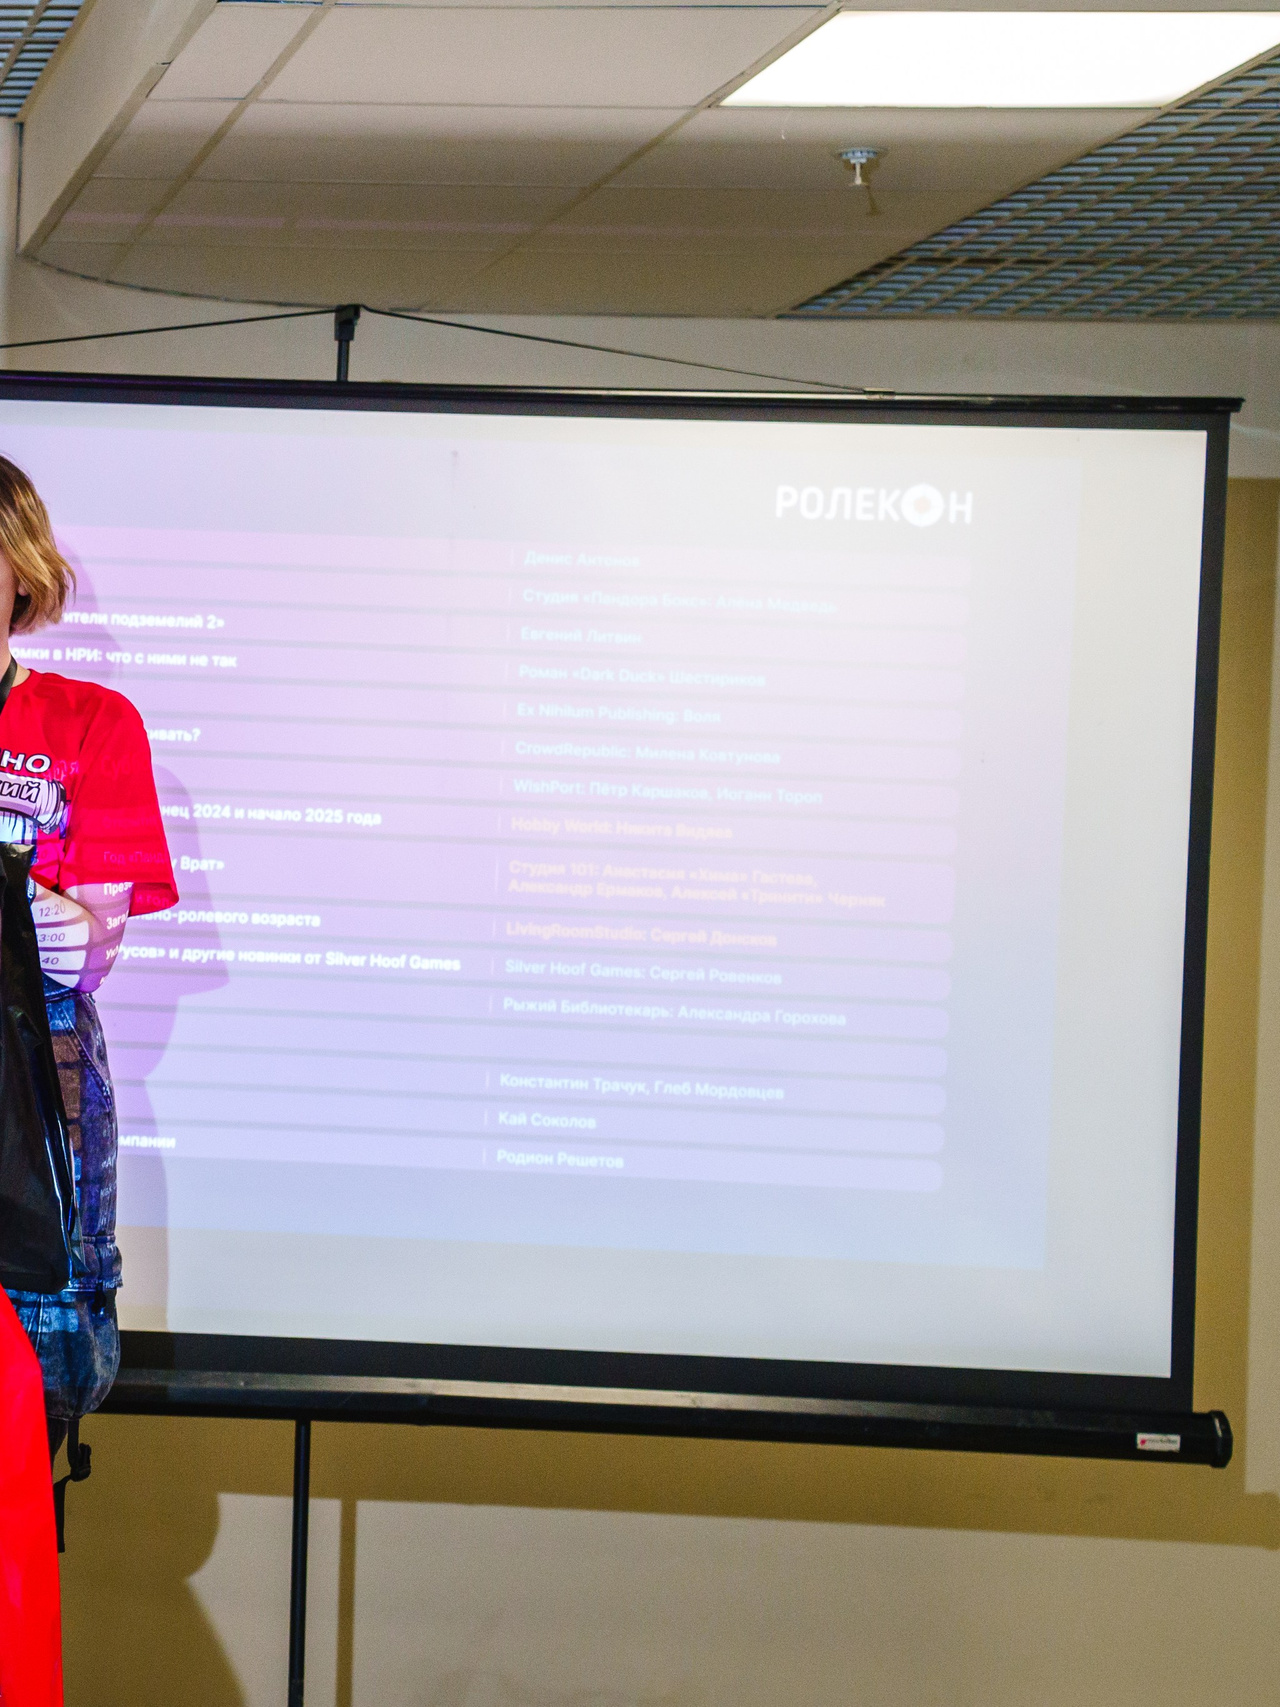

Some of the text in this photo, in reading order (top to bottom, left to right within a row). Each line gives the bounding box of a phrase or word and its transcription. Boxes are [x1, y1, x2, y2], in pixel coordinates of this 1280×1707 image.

[775, 484, 974, 527] РОЛЕКОН
[63, 611, 224, 629] ители подземелий 2»
[520, 627, 582, 642] Евгений
[10, 647, 237, 667] омки в НРИ: что с ними не так
[518, 664, 568, 681] Роман
[516, 704, 534, 717] Ex
[146, 728, 200, 741] ивать?
[636, 746, 695, 761] Милена
[161, 804, 382, 825] нец 2024 и начало 2025 года
[509, 860, 565, 877] Студия
[570, 862, 598, 877] 101:
[39, 901, 66, 917] 12:20
[251, 913, 321, 928] возраста
[37, 933, 66, 943] 3:00
[169, 949, 179, 959] и
[181, 949, 235, 964] другие
[238, 951, 301, 964] новинки
[305, 953, 321, 964] от
[325, 951, 367, 967] Silver
[370, 954, 406, 969] Hoof
[409, 956, 461, 971] Games
[505, 959, 546, 974] Silver
[550, 961, 586, 976] Hoof
[590, 964, 645, 979] Games:
[650, 967, 704, 983] Сергей
[503, 997, 846, 1026] Рыжий Библиотекарь: Александра Горохова
[500, 1074, 785, 1100] Константин Трачук, Глеб Мордовцев
[498, 1112, 596, 1129] Кай Соколов
[119, 1135, 176, 1149] мпании
[497, 1150, 624, 1168] Родион Решетов
